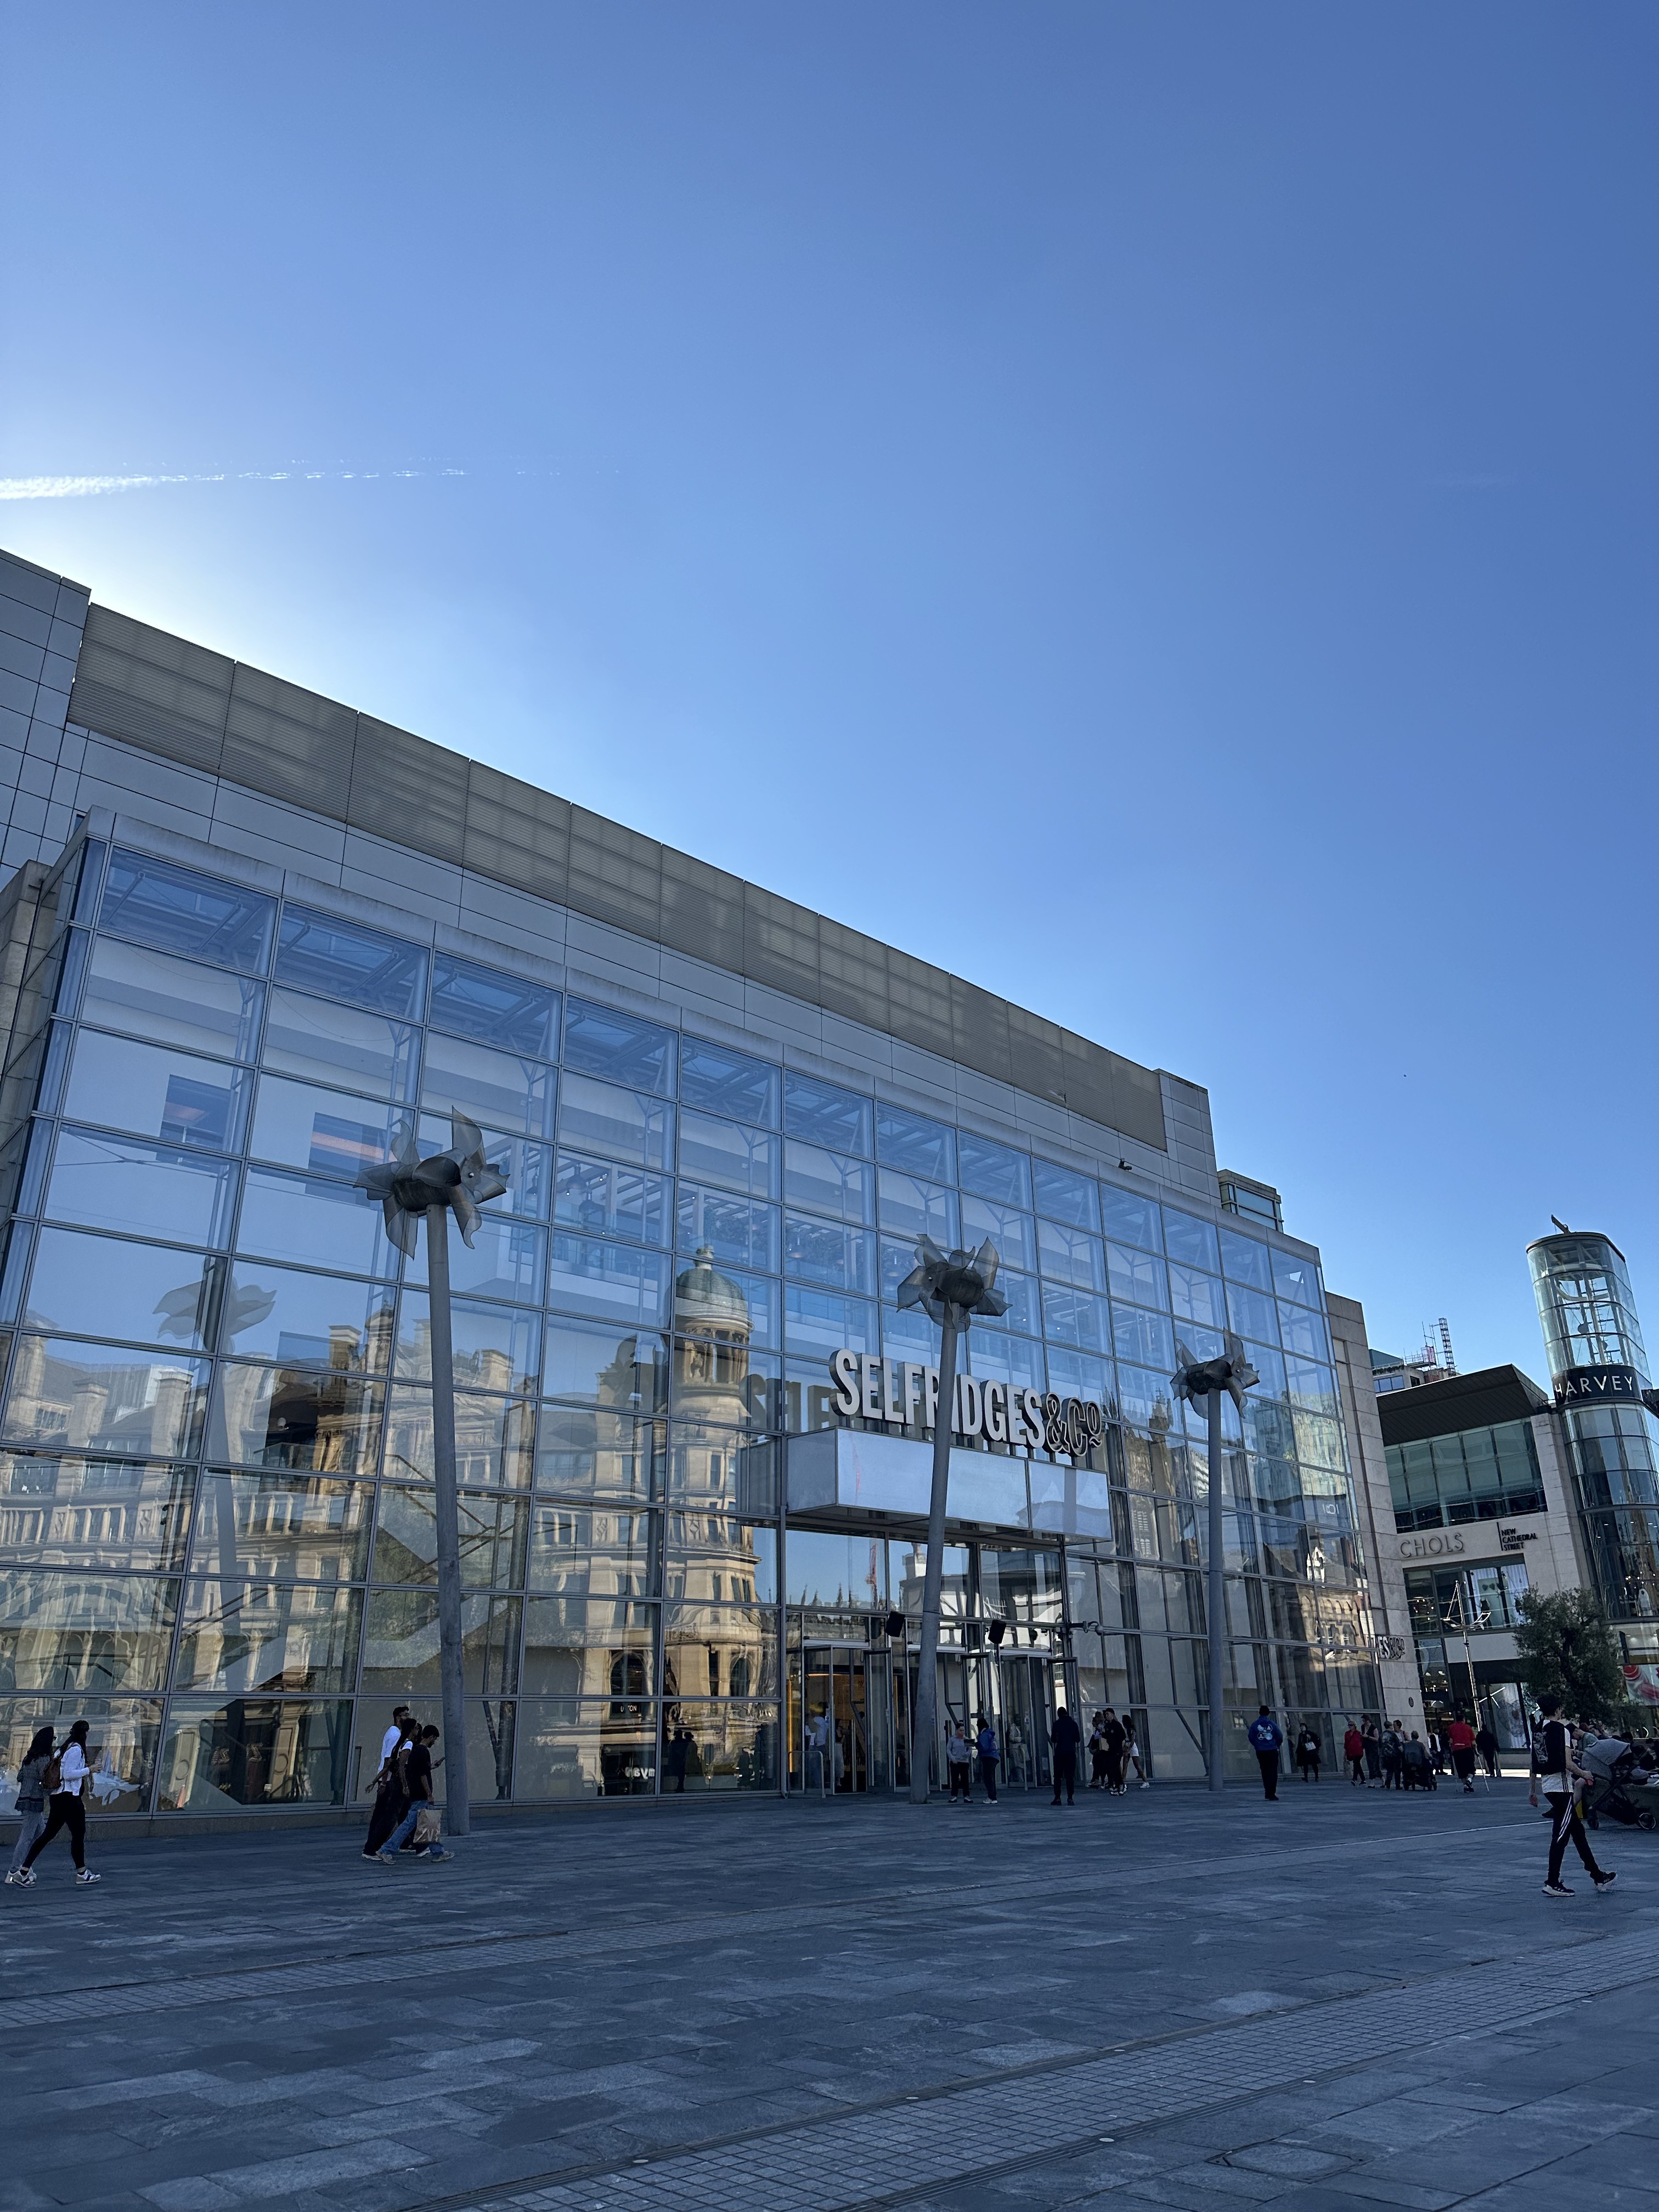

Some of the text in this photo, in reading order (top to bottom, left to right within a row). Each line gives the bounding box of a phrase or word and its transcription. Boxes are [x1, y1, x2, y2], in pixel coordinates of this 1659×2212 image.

[1555, 1375, 1632, 1398] HARVEY
[1501, 1528, 1516, 1536] NEW
[1502, 1533, 1538, 1543] CATHEDRAL
[1400, 1532, 1464, 1558] CHOLS
[1504, 1542, 1523, 1551] STREET
